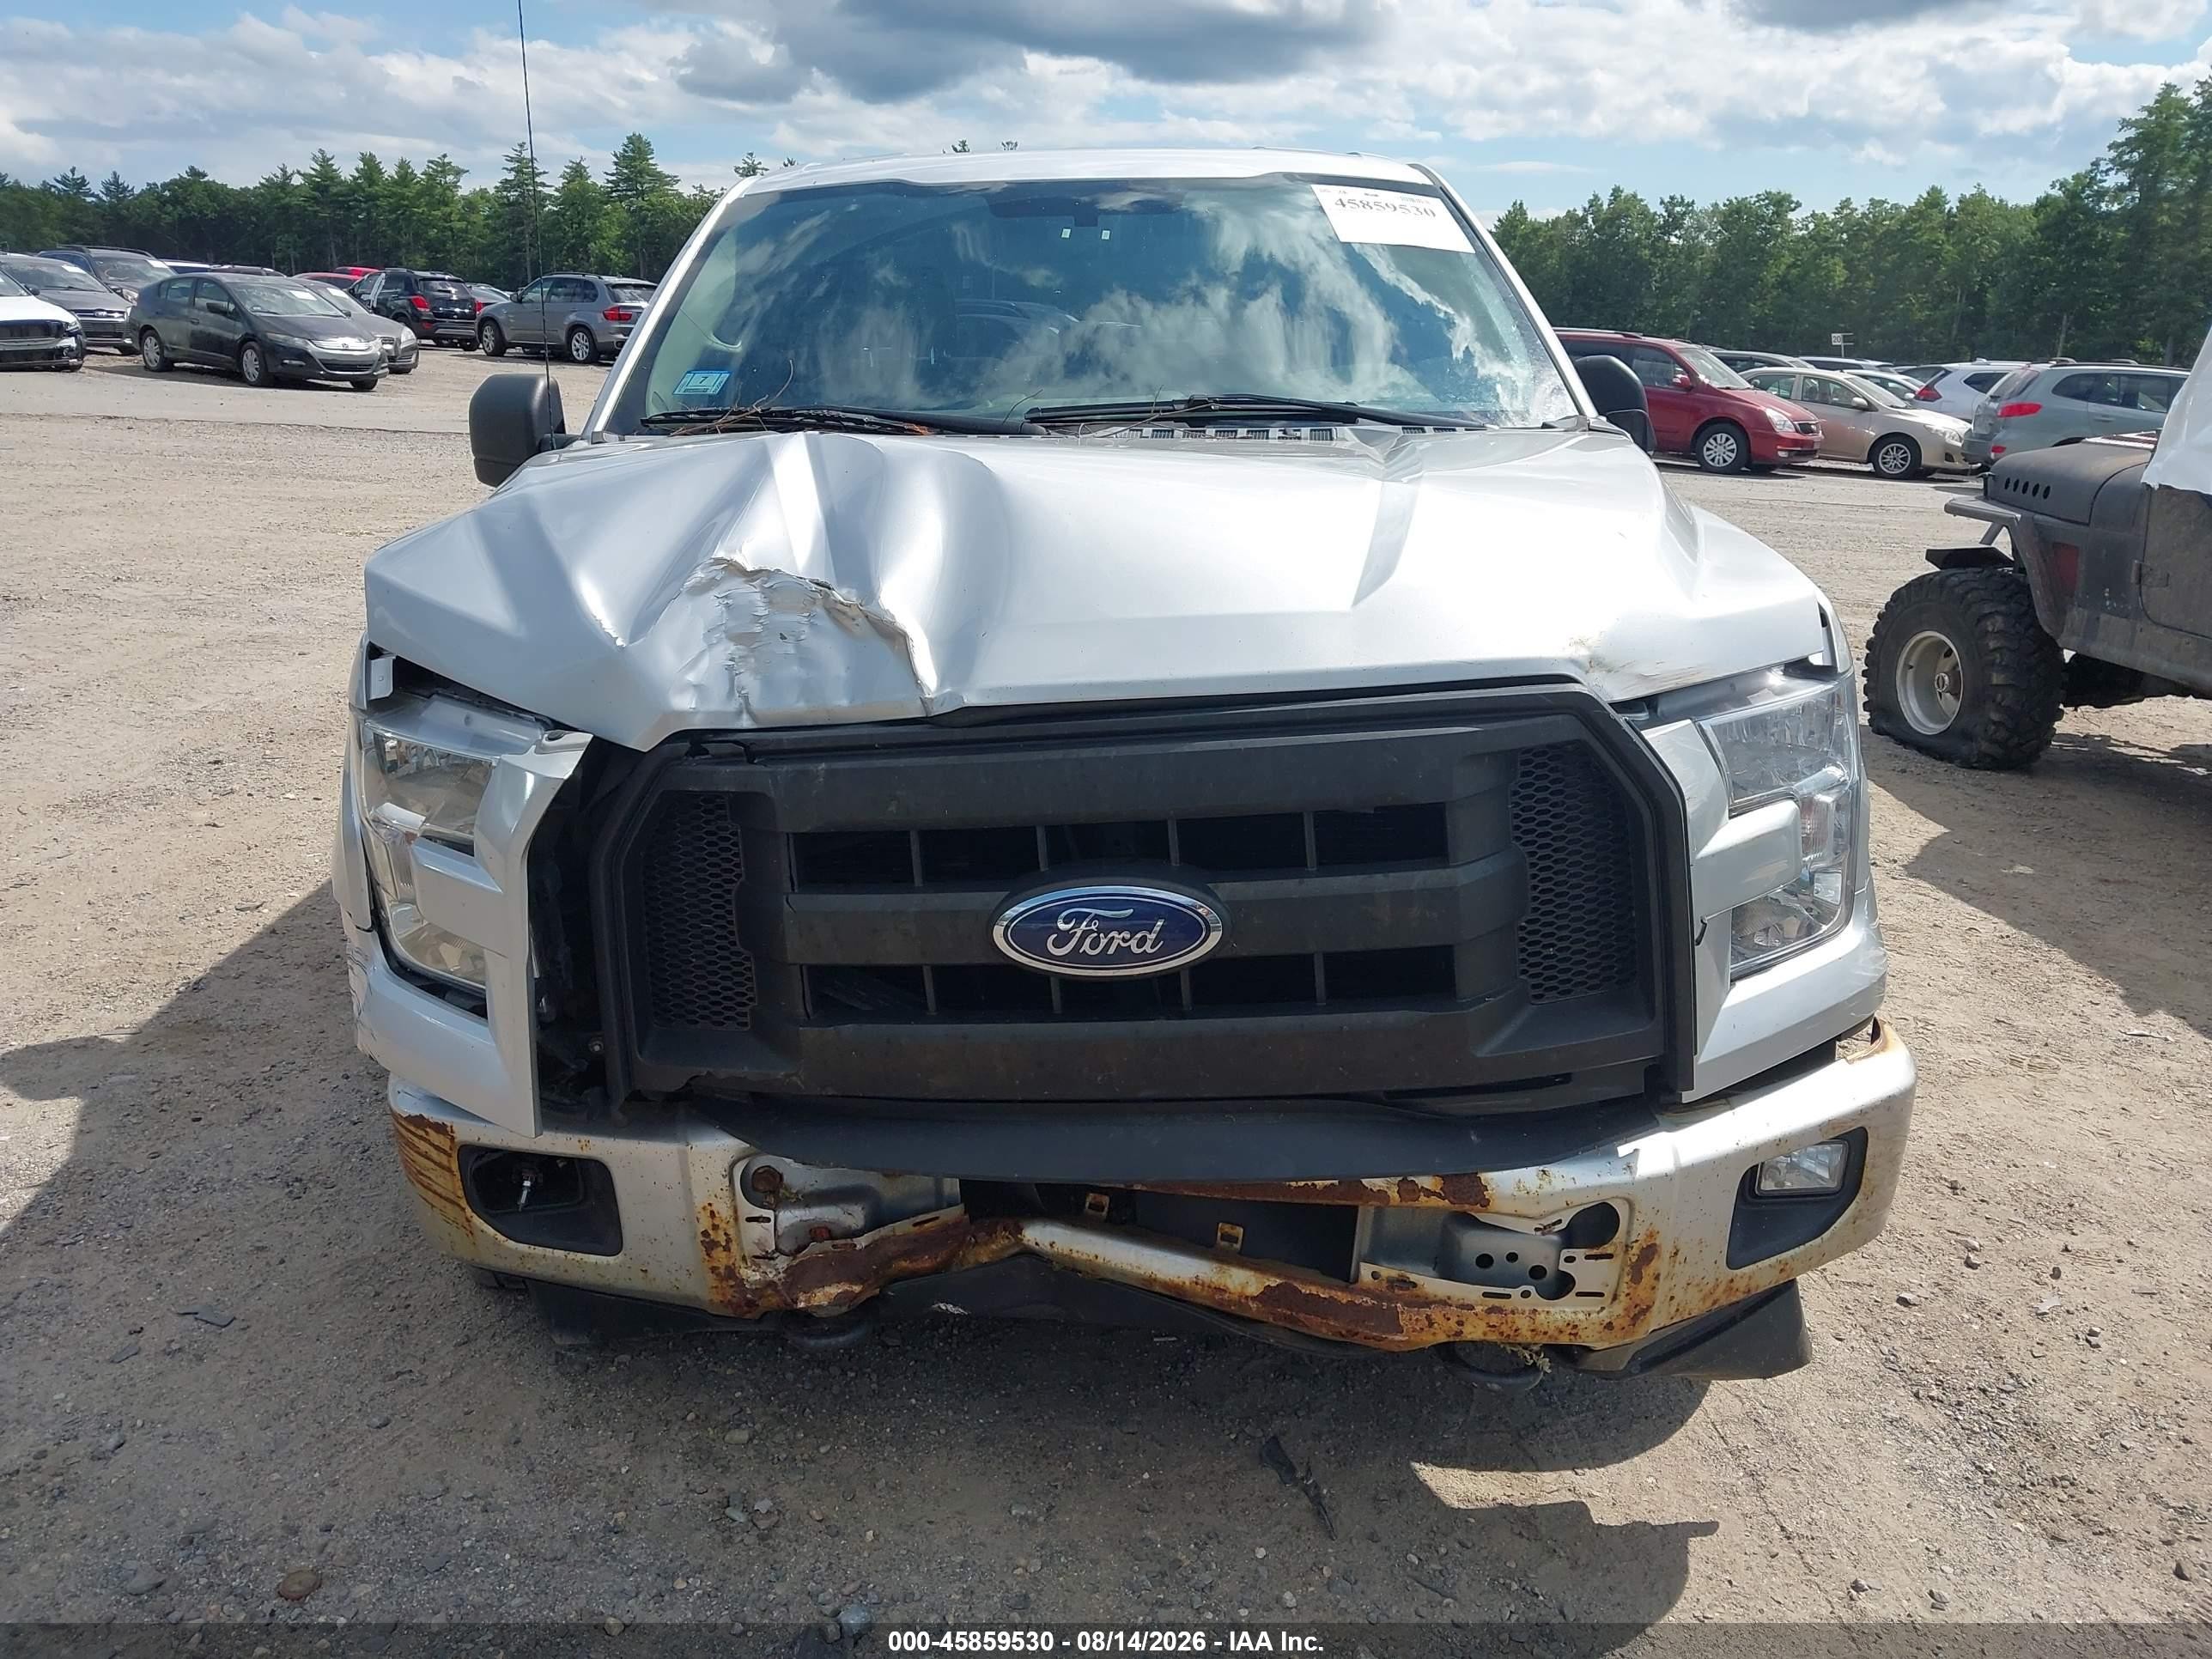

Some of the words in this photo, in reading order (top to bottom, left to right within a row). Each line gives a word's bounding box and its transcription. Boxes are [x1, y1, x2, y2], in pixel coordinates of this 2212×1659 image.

[1334, 197, 1437, 218] 45859530
[1832, 335, 1842, 343] 20
[1046, 907, 1165, 957] Ford
